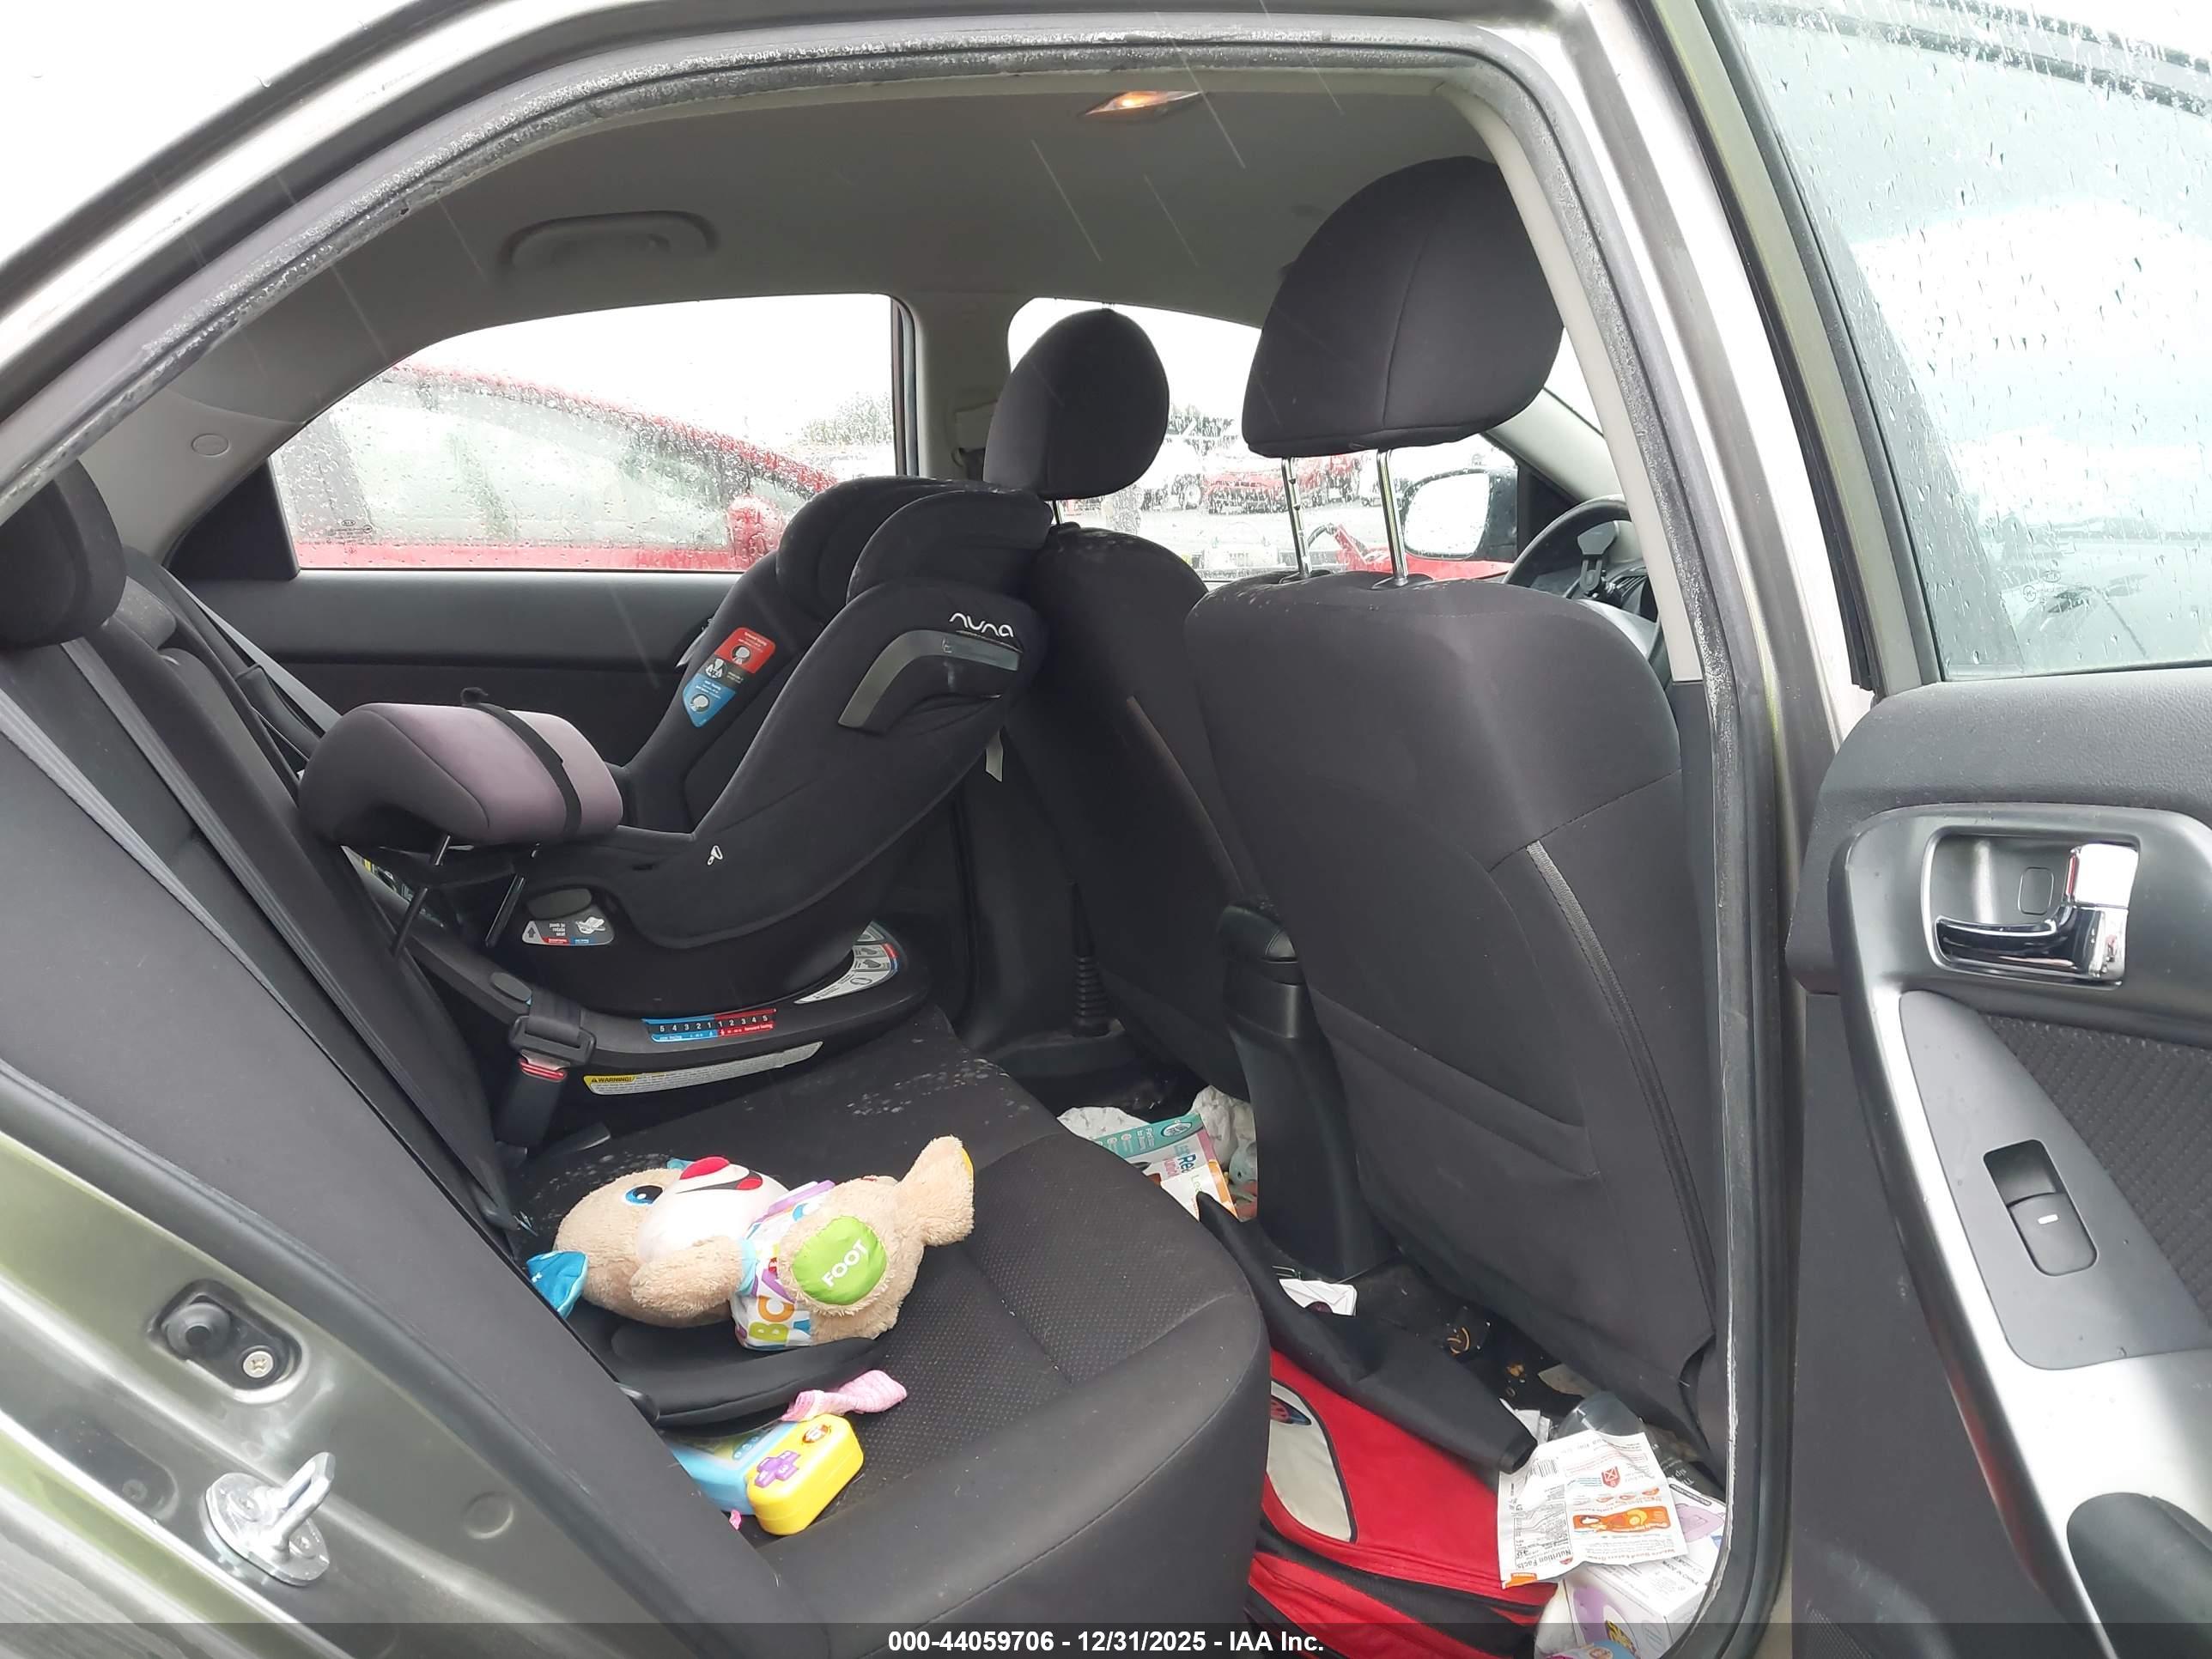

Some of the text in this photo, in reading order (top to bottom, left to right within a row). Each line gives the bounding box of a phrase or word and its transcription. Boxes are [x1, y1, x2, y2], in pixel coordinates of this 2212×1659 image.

[949, 612, 1014, 637] nuna
[821, 1239, 868, 1288] FOOT
[1517, 1559, 1538, 1570] Facts
[1539, 1548, 1571, 1563] Nutrition
